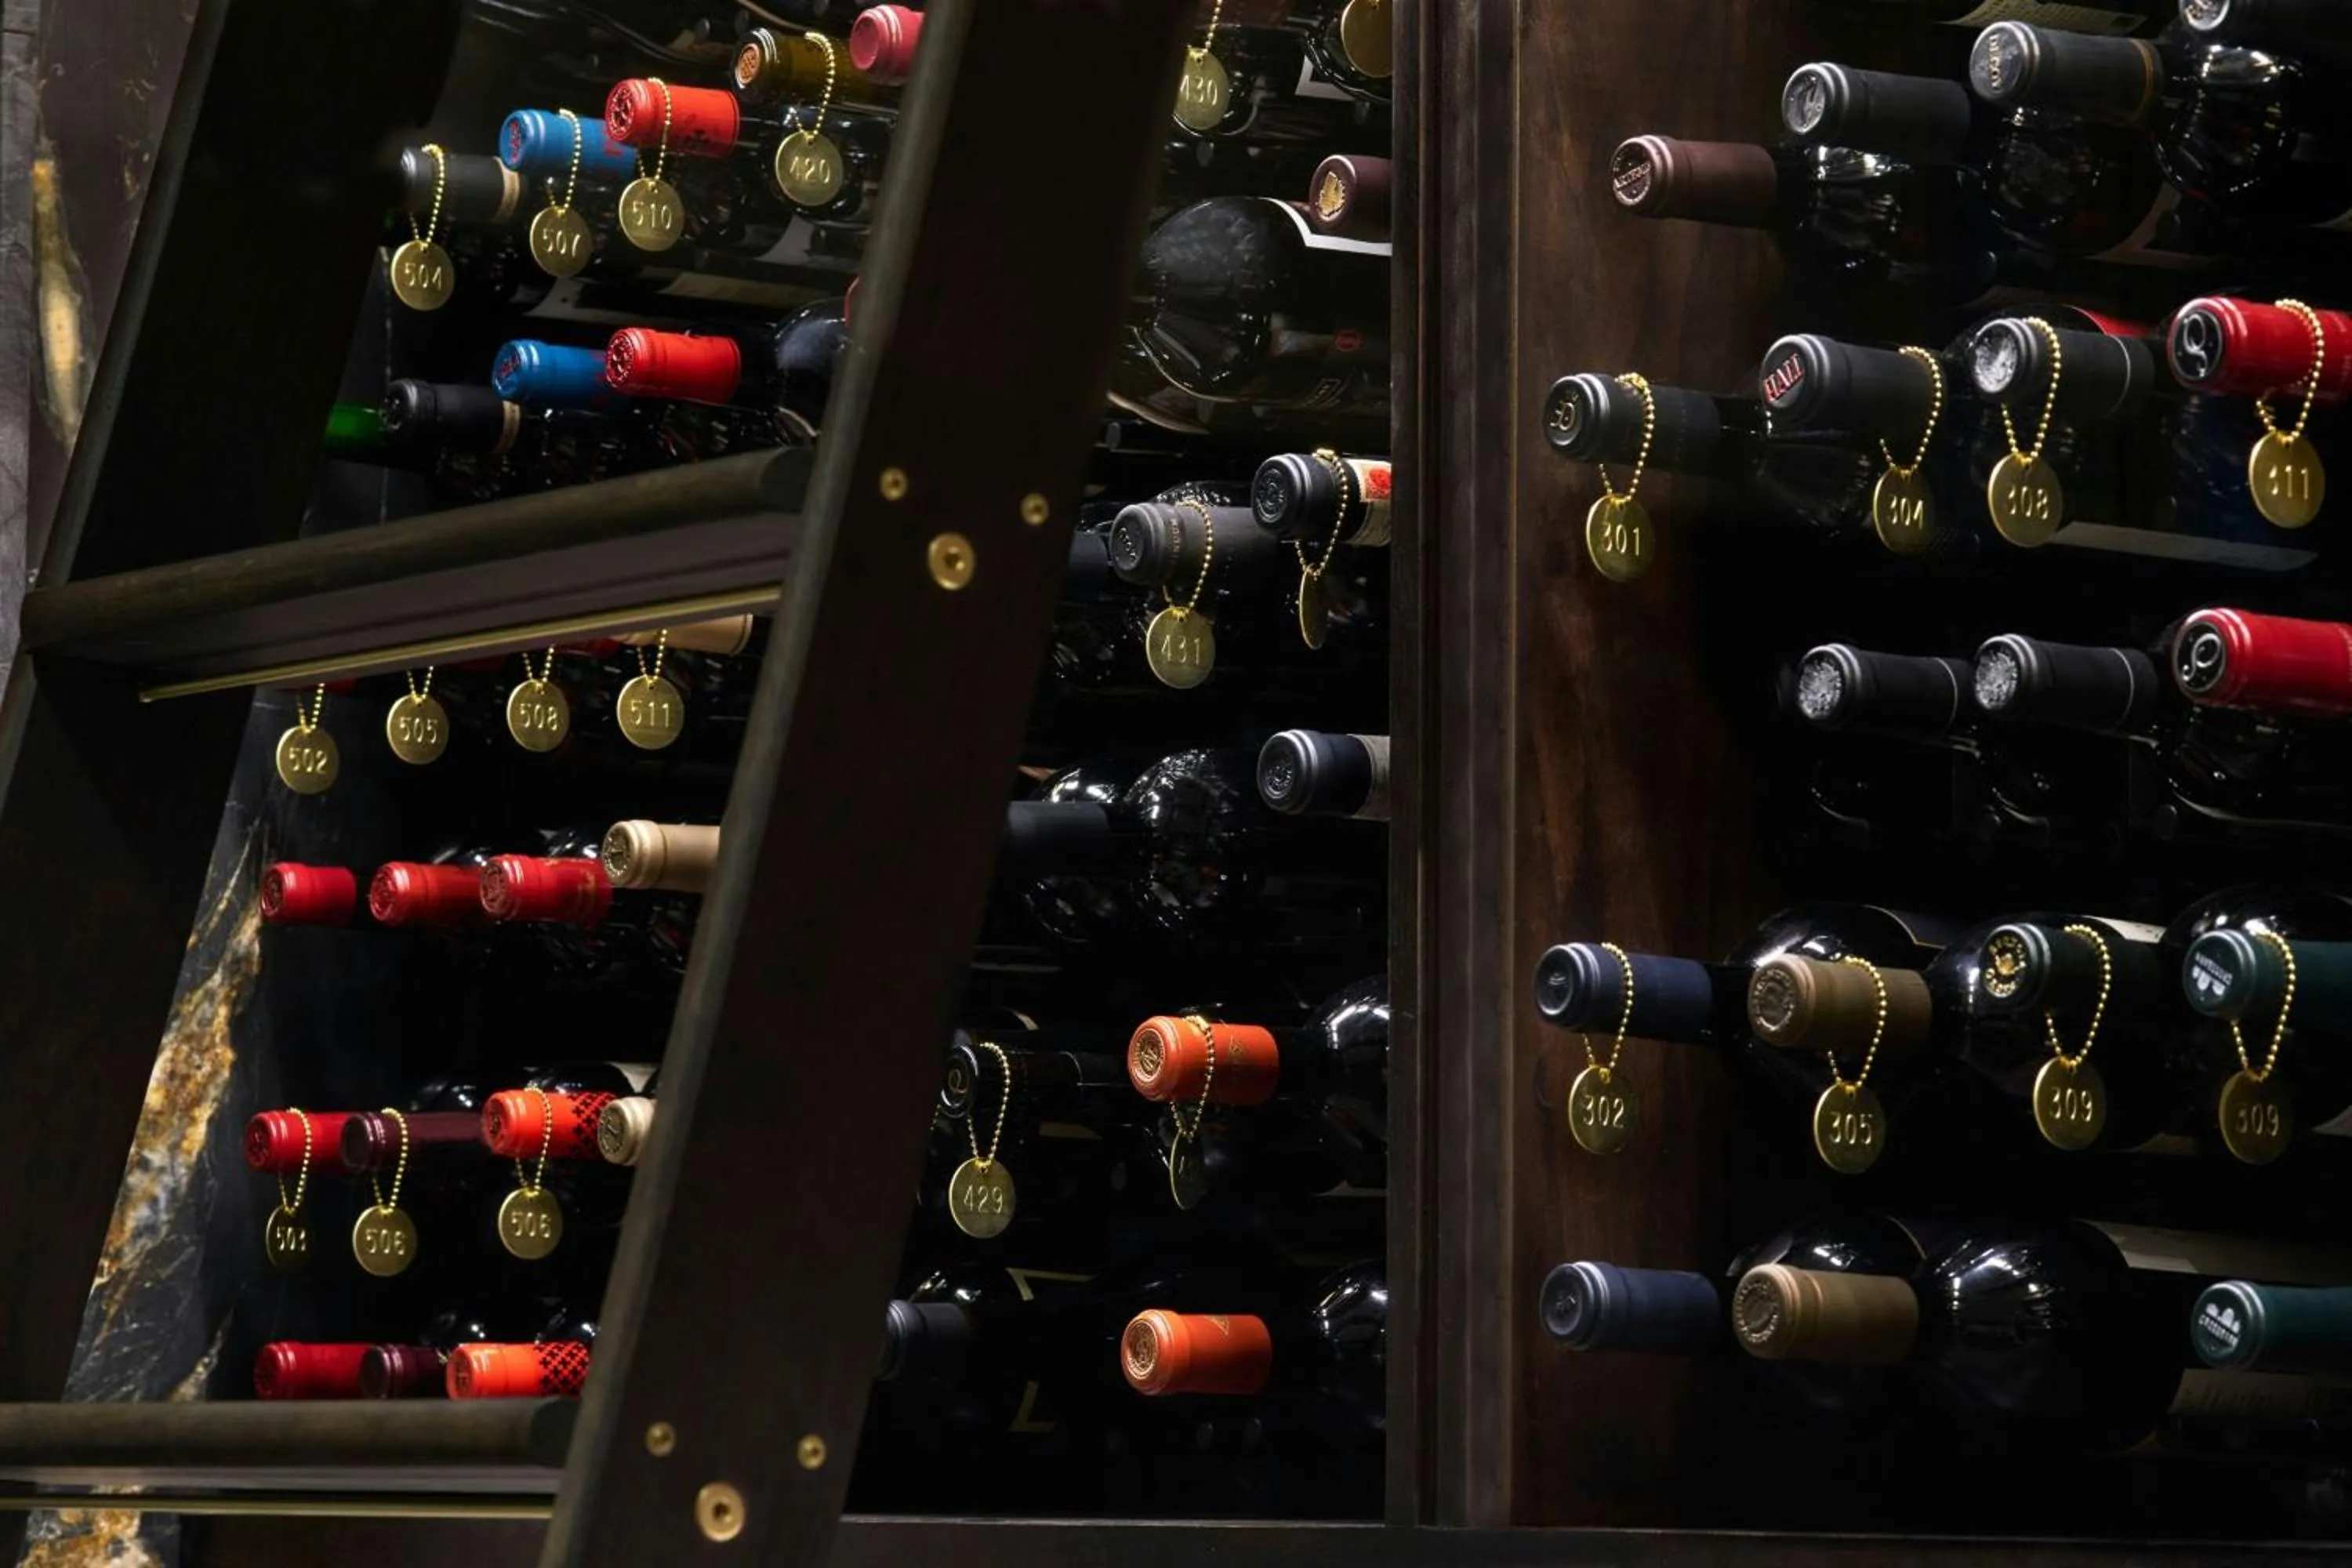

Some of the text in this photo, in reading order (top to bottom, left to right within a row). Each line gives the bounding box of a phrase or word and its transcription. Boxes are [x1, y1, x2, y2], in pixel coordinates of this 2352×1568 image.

[632, 201, 673, 230] 510
[542, 227, 581, 257] 507
[404, 263, 443, 290] 504
[1763, 350, 1806, 401] HALL
[1889, 495, 1924, 530] 304
[1601, 521, 1640, 557] 301
[1161, 634, 1200, 666] 431
[519, 702, 558, 731] 508
[630, 699, 670, 728] 511
[399, 717, 437, 744] 505
[289, 746, 328, 775] 502
[1582, 1094, 1624, 1129] 302
[2050, 1087, 2092, 1123] 309
[1829, 1112, 1873, 1145] 305
[964, 1186, 1004, 1214] 429
